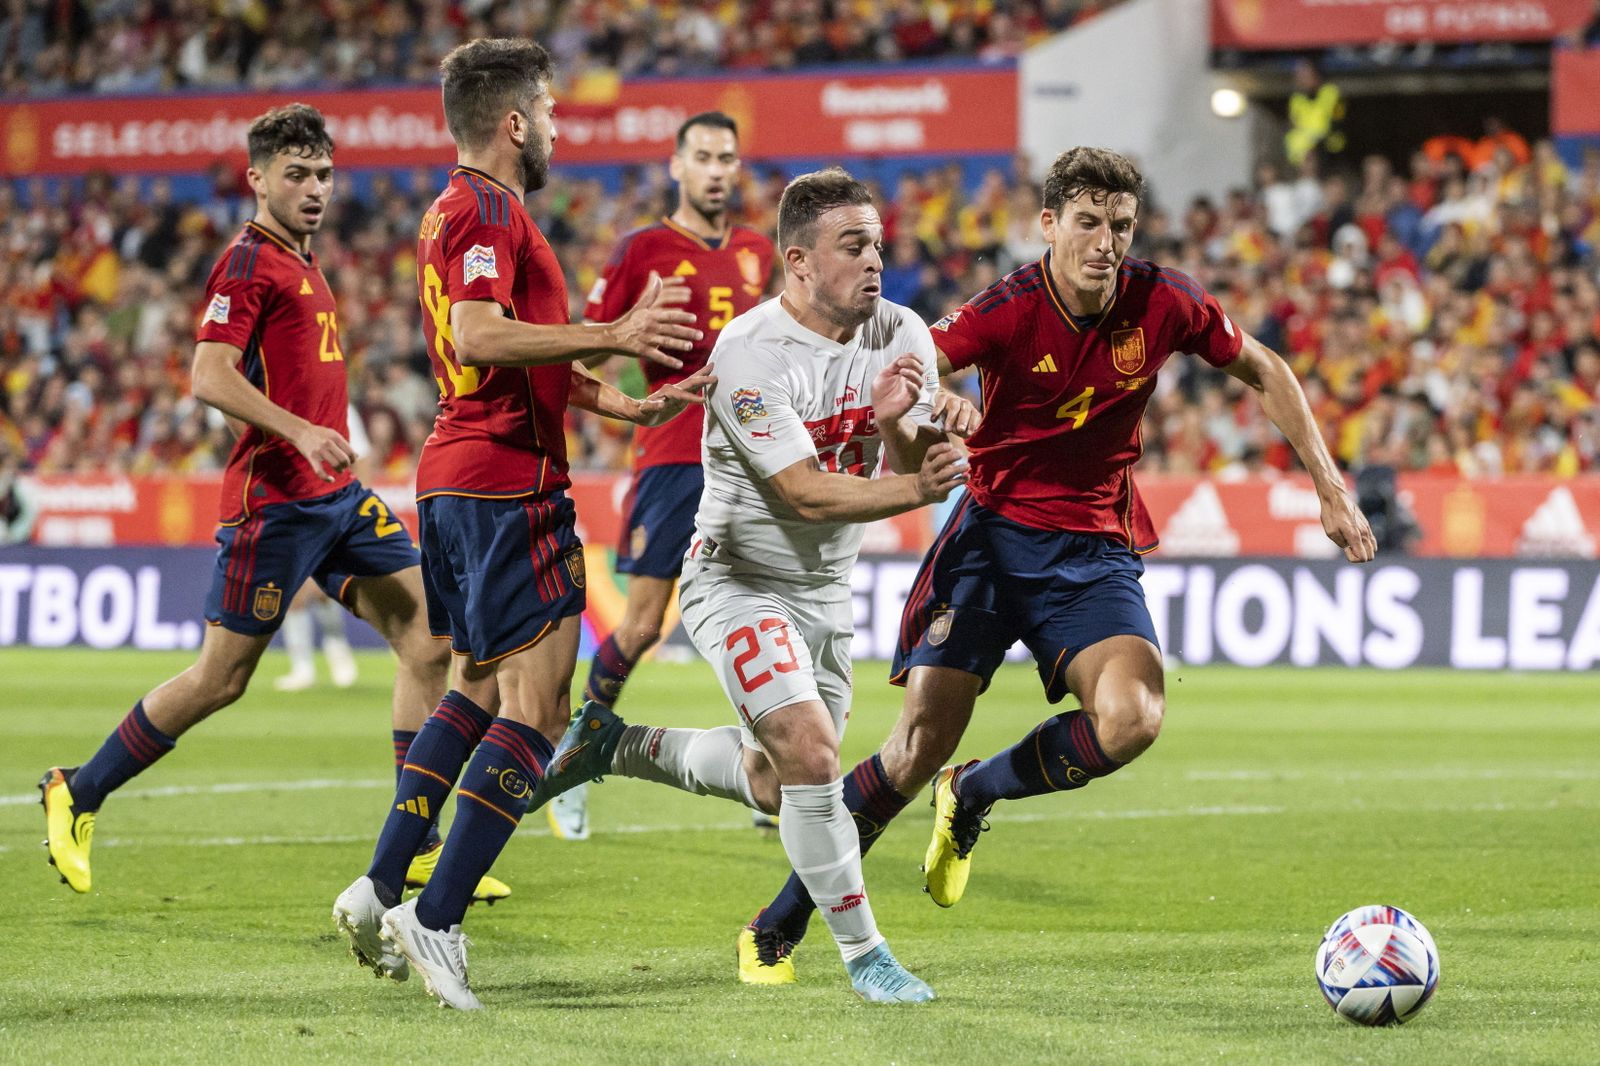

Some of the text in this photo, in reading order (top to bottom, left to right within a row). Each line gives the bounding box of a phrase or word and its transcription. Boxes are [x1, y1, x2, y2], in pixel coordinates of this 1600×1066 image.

[709, 287, 734, 330] 5
[1056, 387, 1095, 430] 4
[1138, 563, 1424, 668] TIONS
[726, 617, 800, 693] 23
